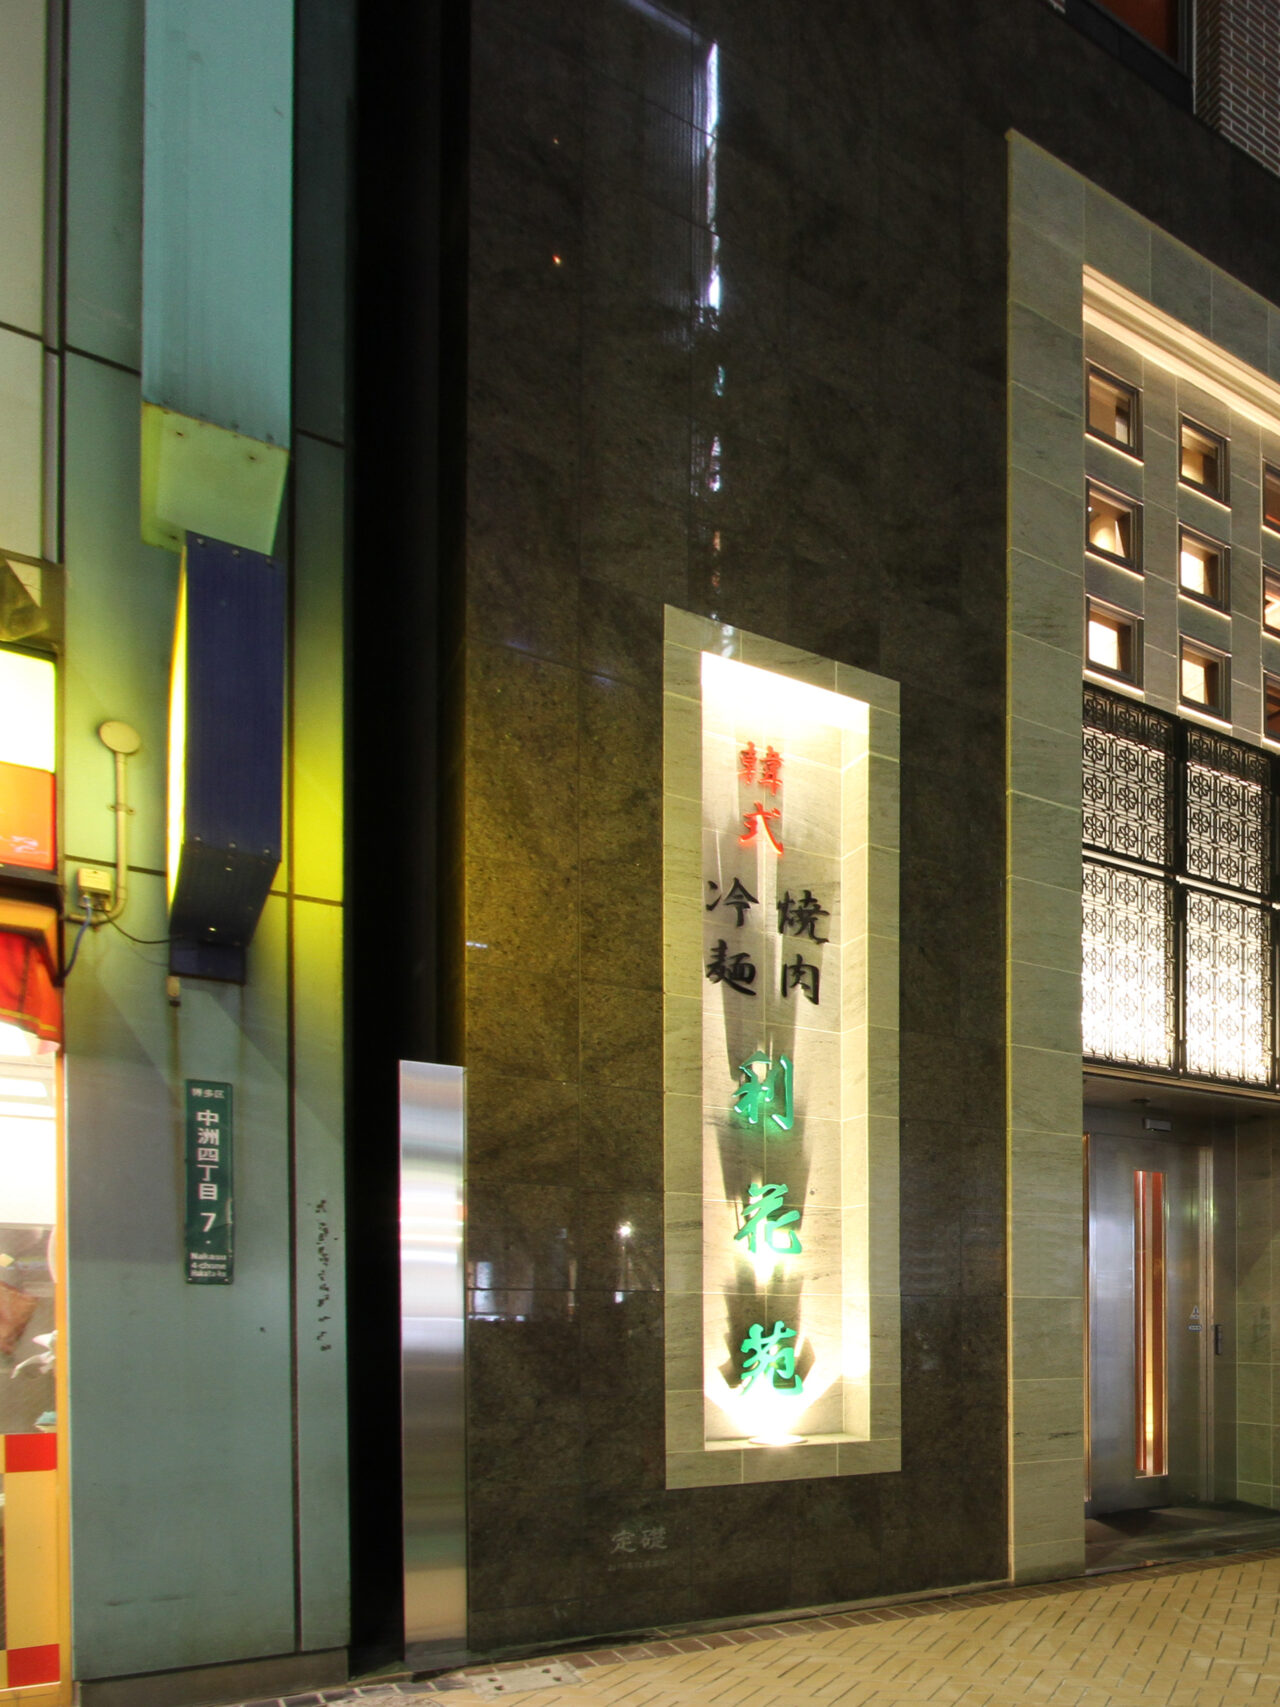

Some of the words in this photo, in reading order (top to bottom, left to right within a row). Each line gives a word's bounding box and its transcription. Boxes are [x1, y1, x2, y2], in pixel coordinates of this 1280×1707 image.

[738, 741, 784, 856] 韓式
[706, 877, 759, 996] 冷麺
[196, 1109, 220, 1201] 中洲四丁目
[200, 1213, 217, 1234] 7
[732, 1050, 803, 1396] 利花苑
